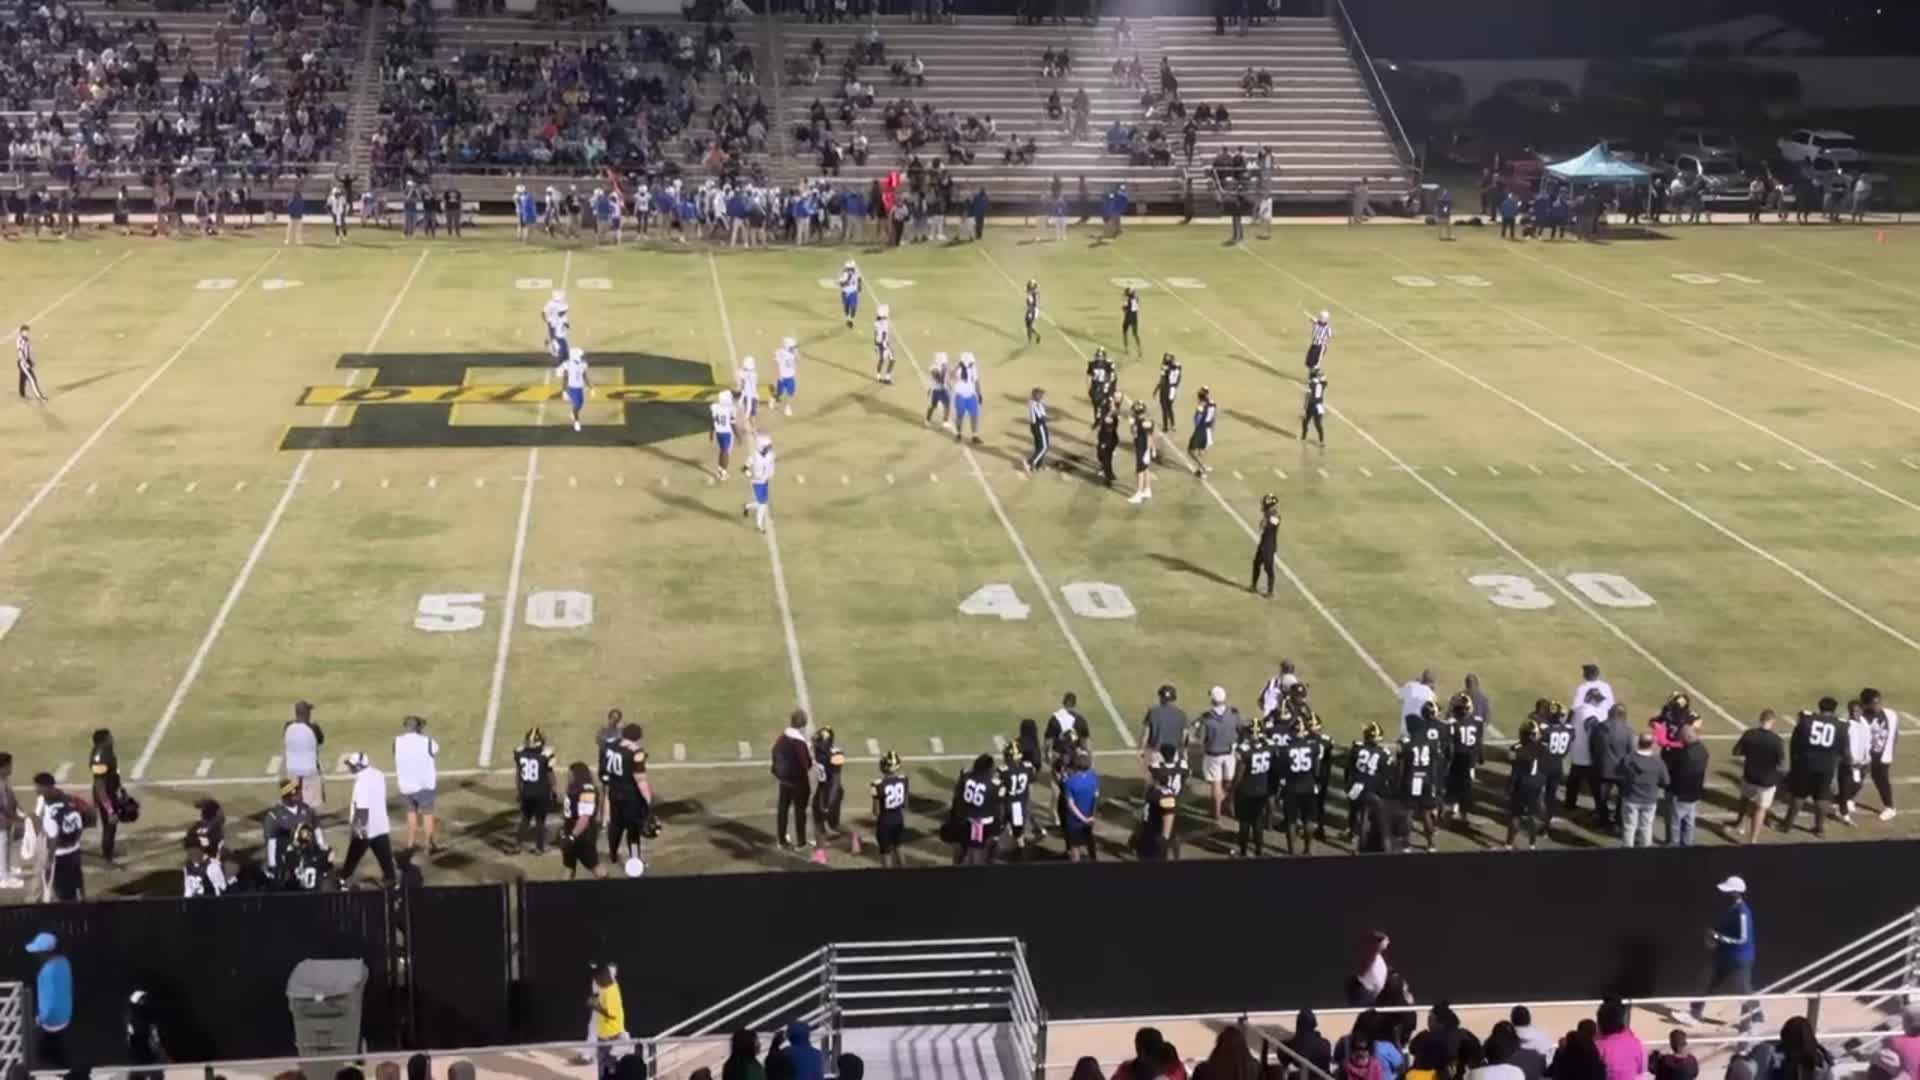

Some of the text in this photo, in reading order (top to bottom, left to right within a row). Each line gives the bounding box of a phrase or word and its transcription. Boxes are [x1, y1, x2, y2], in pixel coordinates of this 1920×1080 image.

[958, 582, 1136, 620] 40
[1467, 573, 1656, 610] 30
[414, 591, 594, 632] 50
[1460, 726, 1477, 746] 16
[1549, 732, 1570, 755] 88
[1809, 719, 1836, 748] 50
[520, 757, 539, 782] 38
[606, 748, 623, 776] 70
[1251, 751, 1271, 775] 56
[1289, 747, 1312, 773] 35
[1355, 749, 1380, 776] 24
[1412, 745, 1430, 767] 14
[963, 779, 986, 807] 66
